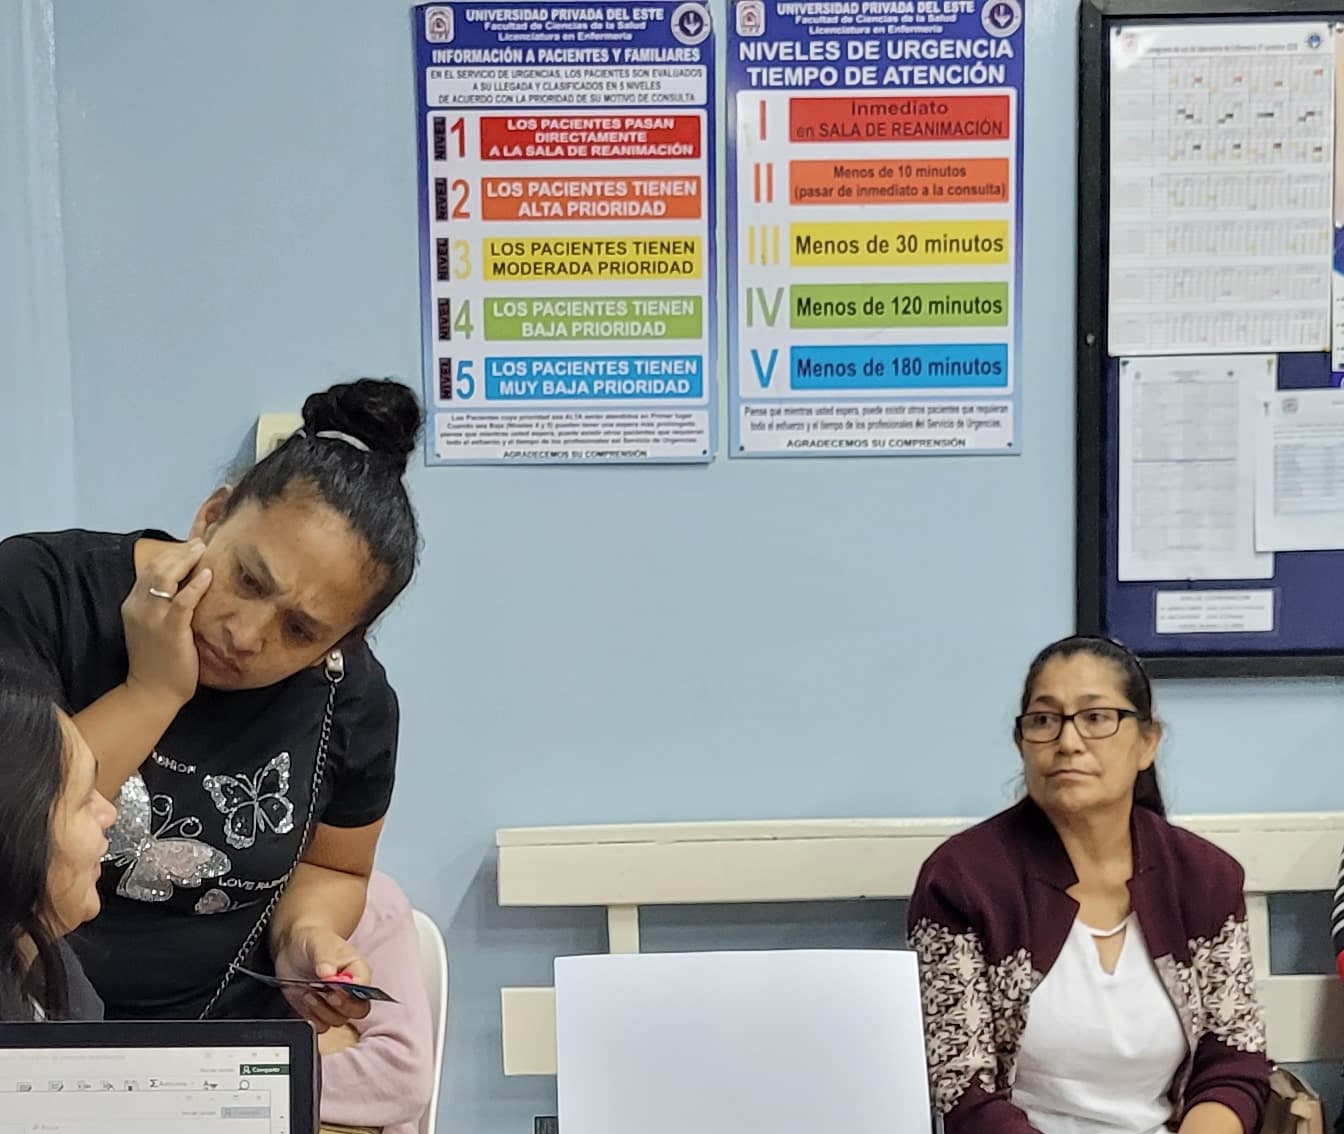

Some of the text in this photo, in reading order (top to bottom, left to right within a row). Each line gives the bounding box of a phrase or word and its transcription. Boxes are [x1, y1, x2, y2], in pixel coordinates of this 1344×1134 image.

[466, 8, 664, 21] UNIVERSIDAD PRIVADA DEL ESTE
[777, 1, 975, 15] UNIVERSIDAD PRIVADA DEL ESTE
[484, 21, 646, 31] Facultad de Ciencias de la Salud
[796, 16, 838, 24] Facultad
[856, 15, 898, 23] Ciencias
[901, 15, 914, 23] de
[916, 15, 926, 23] la
[927, 14, 956, 22] Salud
[498, 32, 560, 41] Licenciatura
[562, 33, 575, 41] en
[809, 26, 871, 35] Licenciatura
[872, 26, 885, 34] en
[432, 46, 701, 63] INFORMACIÓN A PACIENTES Y FAMILIARES
[739, 38, 1014, 61] NIVELES DE URGENCIA
[431, 70, 441, 79] EN
[444, 70, 454, 79] EL
[457, 70, 495, 79] SERVICIO
[498, 70, 509, 79] DE
[565, 69, 581, 78] LOS
[584, 69, 630, 78] PACIENTES
[632, 69, 650, 77] SON
[652, 68, 702, 77] EVALUADOS
[746, 61, 1005, 86] TIEMPO DE ATENCIÓN
[473, 81, 661, 91] A SU LLEGADA Y CLASIFICADOS EN 5 NIVELES
[439, 95, 450, 104] DE
[452, 95, 493, 104] ACUERDO
[496, 95, 513, 104] CON
[516, 95, 526, 104] LA
[529, 94, 574, 103] PRIORIDAD
[576, 94, 587, 103] DE
[590, 94, 601, 103] SU
[604, 94, 636, 102] MOTIVO
[638, 94, 649, 102] DE
[851, 100, 948, 116] Inmediato
[507, 117, 674, 131] LOS PACIENTES PASAN
[796, 118, 1002, 138] en SALA DE REANIMACIÓN
[450, 117, 465, 158] 1
[535, 131, 647, 143] DIRECTAMENTE
[489, 142, 694, 157] A LA SALA DE REANIMACIÓN
[833, 165, 967, 178] Menos de 10 minutos
[486, 181, 696, 198] LOS PACIENTES TIENEN
[754, 163, 773, 203] II
[452, 179, 470, 219] 2
[794, 183, 1006, 201] (pasar de inmediato a la consulta)
[518, 201, 666, 217] ALTA PRIORIDAD
[491, 240, 695, 256] LOS PACIENTES TIENEN
[749, 224, 780, 265] III
[796, 233, 1004, 254] Menos de 30 minutos
[452, 240, 472, 279] 3
[493, 261, 694, 276] MODERADA PRIORIDAD
[493, 301, 694, 317] LOS PACIENTES TIENEN
[746, 287, 784, 328] IV
[797, 295, 1002, 317] Menos de 120 minutos
[454, 299, 474, 340] 4
[522, 321, 666, 337] BAJA PRIORIDAD
[492, 360, 697, 376] LOS PACIENTES TIENEN
[751, 349, 778, 388] V
[797, 357, 1002, 378] Menos de 180 minutos
[456, 360, 475, 399] 5
[500, 380, 690, 395] MUY BAJA PRIORIDAD
[787, 437, 966, 448] AGRADECEMOS SU COMPRENSIÓN
[585, 449, 647, 458] COMPRENSIÓN
